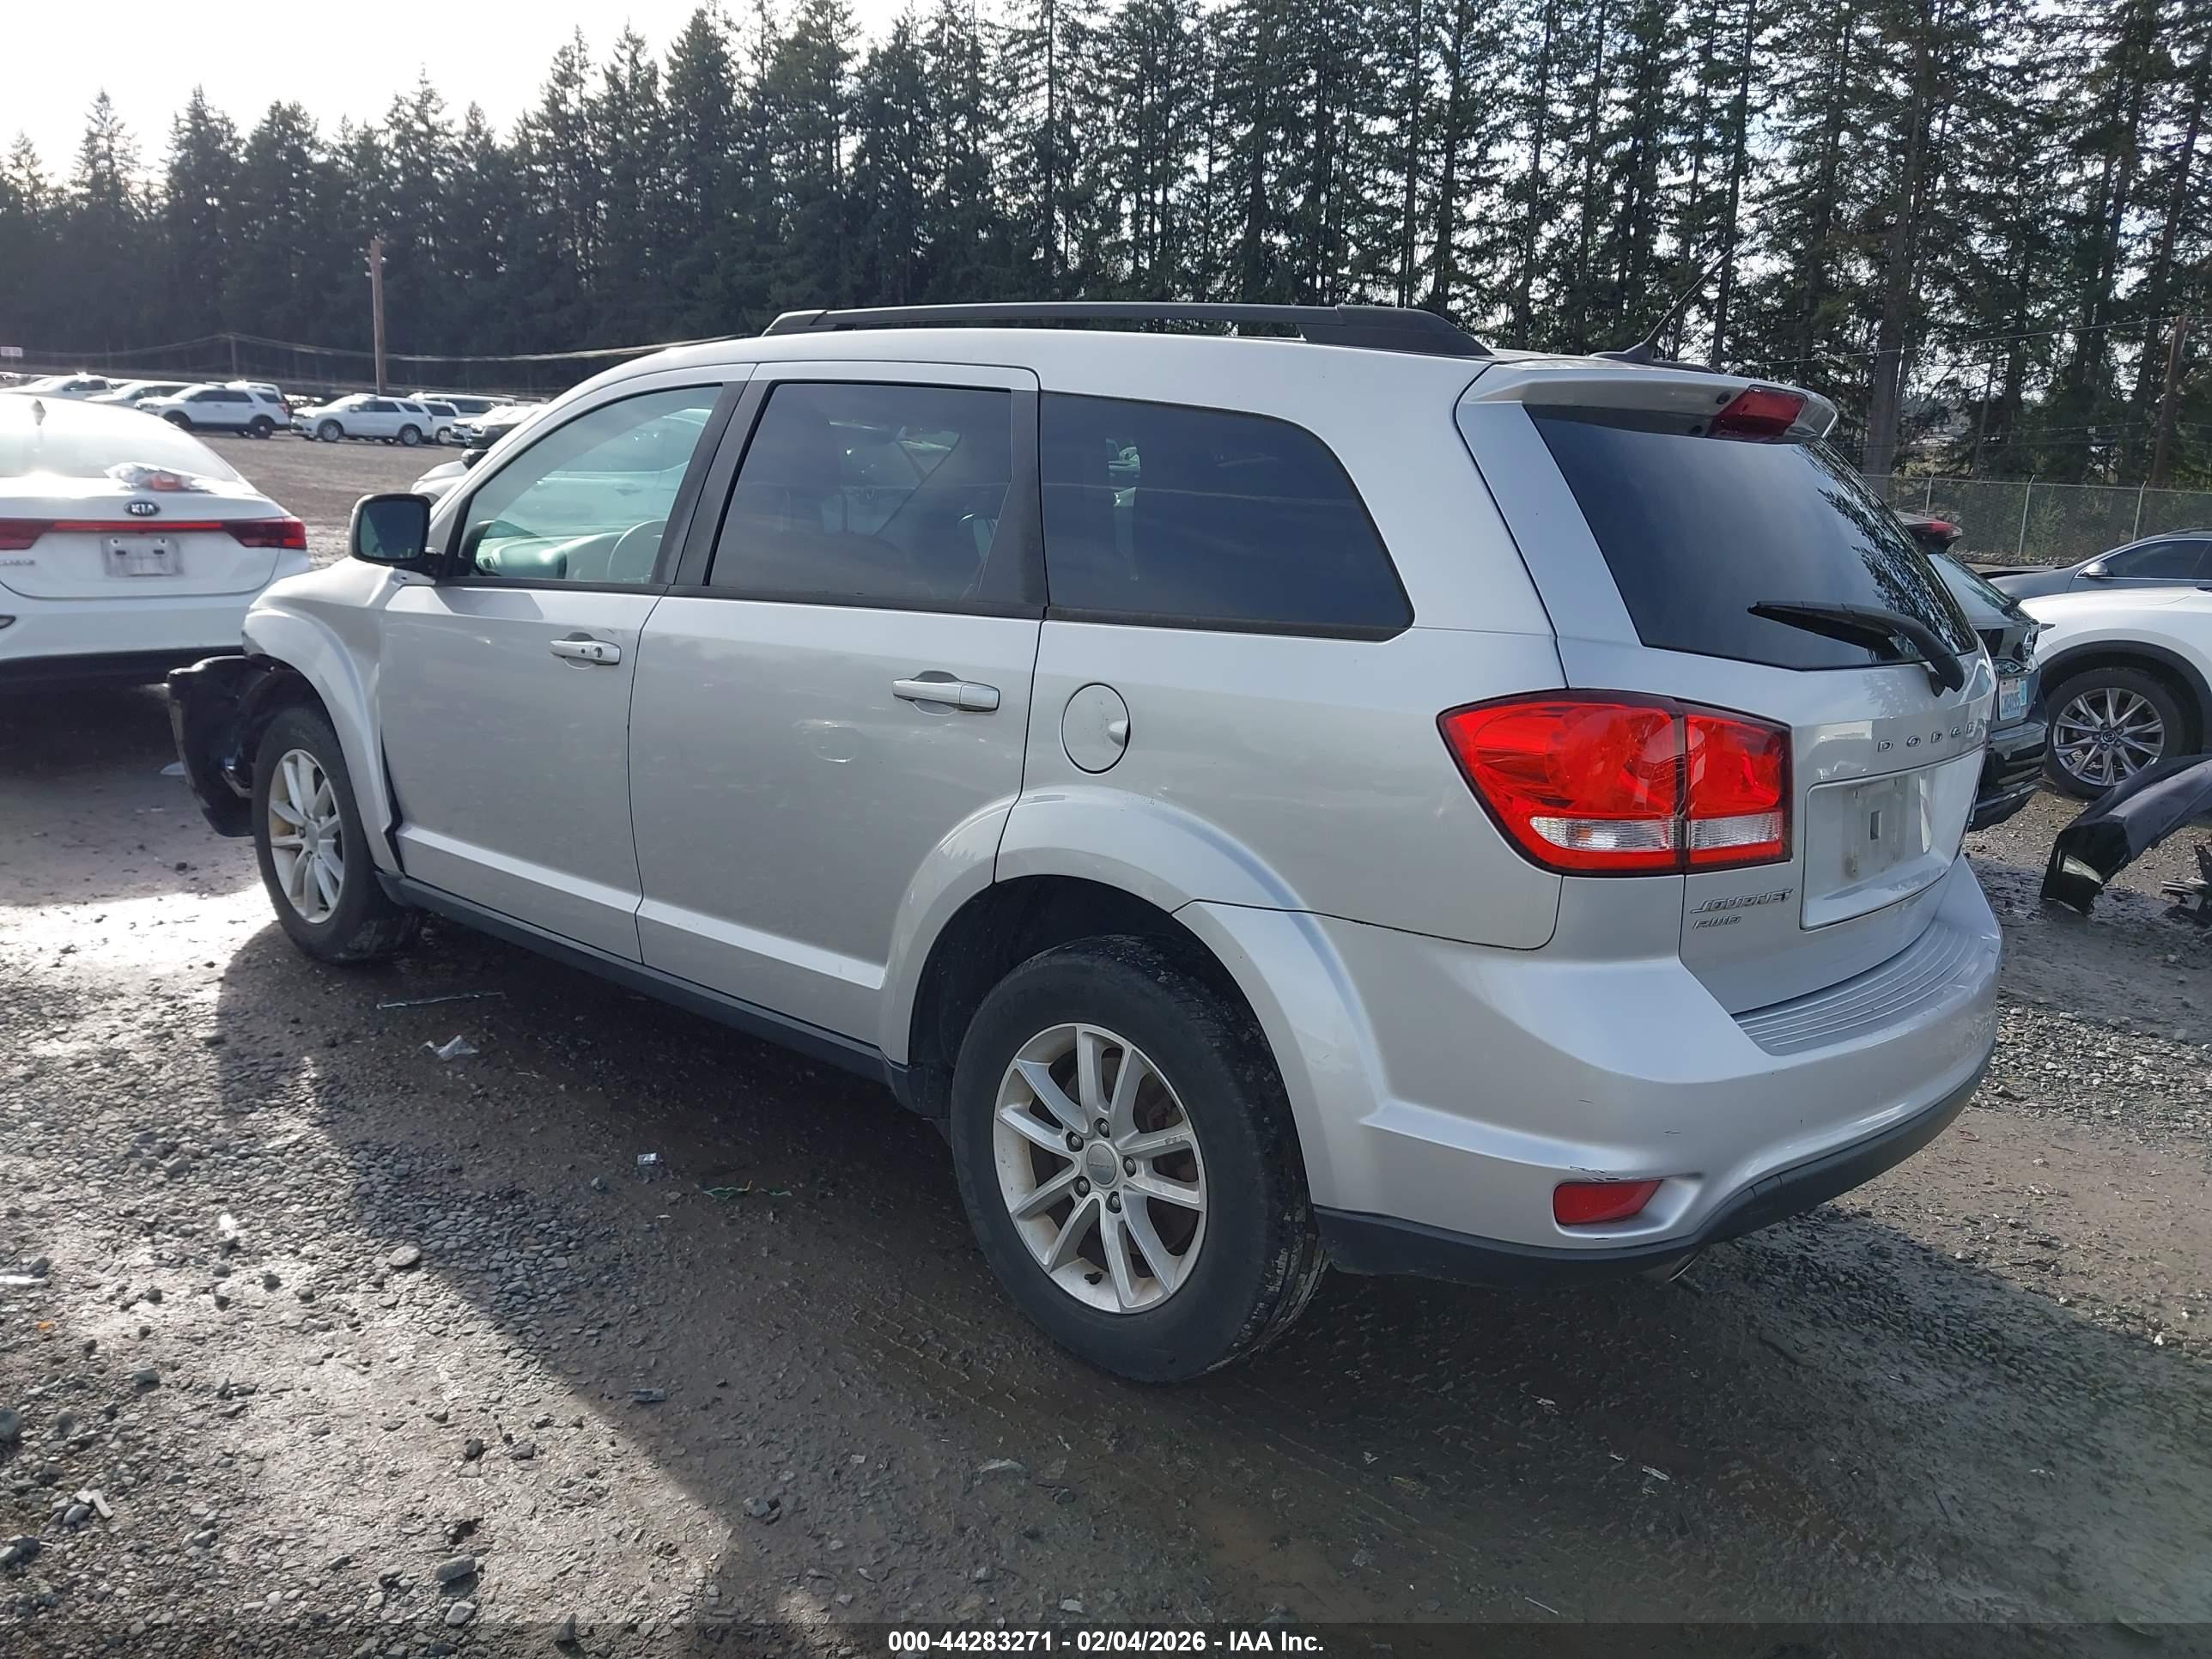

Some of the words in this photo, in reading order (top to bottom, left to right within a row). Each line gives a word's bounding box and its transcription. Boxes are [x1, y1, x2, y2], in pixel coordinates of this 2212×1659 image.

[131, 502, 155, 515] KIA
[1876, 720, 1975, 752] DODGE
[1689, 888, 1794, 915] JOURNEY
